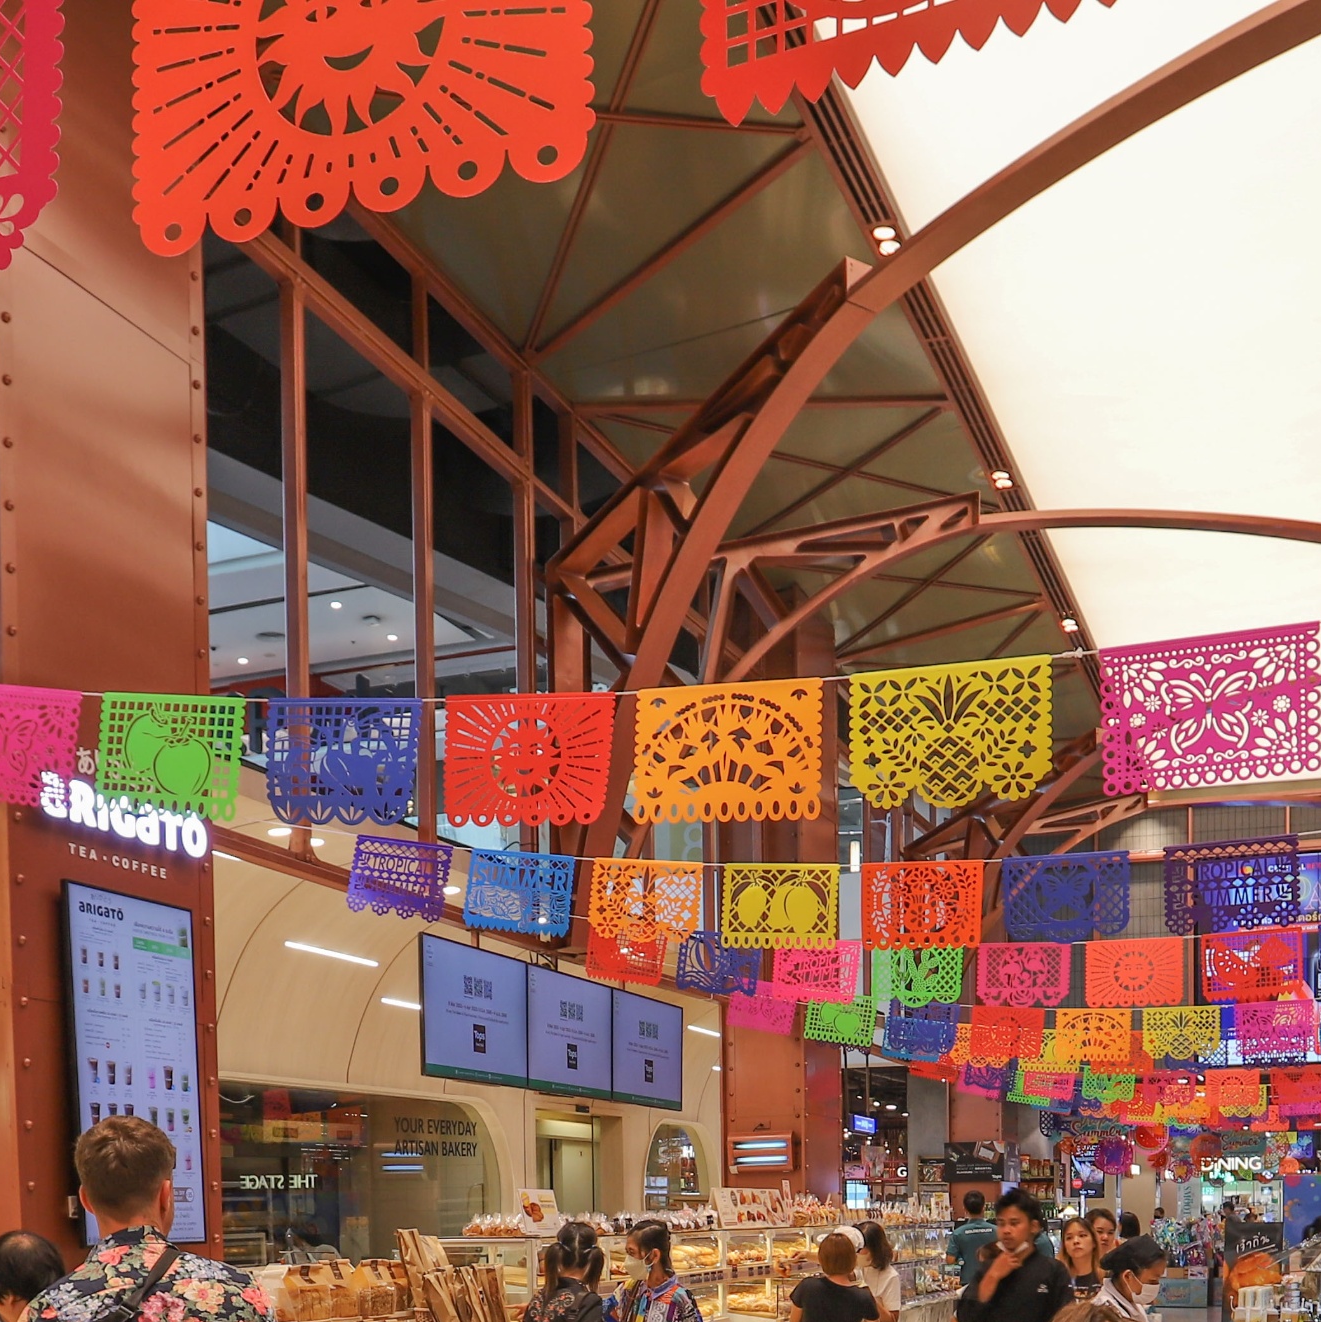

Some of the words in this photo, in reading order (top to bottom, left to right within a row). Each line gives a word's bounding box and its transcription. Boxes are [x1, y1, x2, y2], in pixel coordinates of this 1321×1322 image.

[68, 842, 98, 862] TEA
[111, 855, 168, 880] COFFEE
[1196, 855, 1270, 881] ROPICAL
[476, 865, 567, 892] SUMMER
[1200, 885, 1272, 908] UMMER
[394, 1116, 425, 1134] YOUR
[428, 1118, 477, 1137] EVERYDAY
[394, 1139, 439, 1156] ARTISAN
[441, 1141, 478, 1157] BAKERY
[1201, 1156, 1262, 1171] DINING
